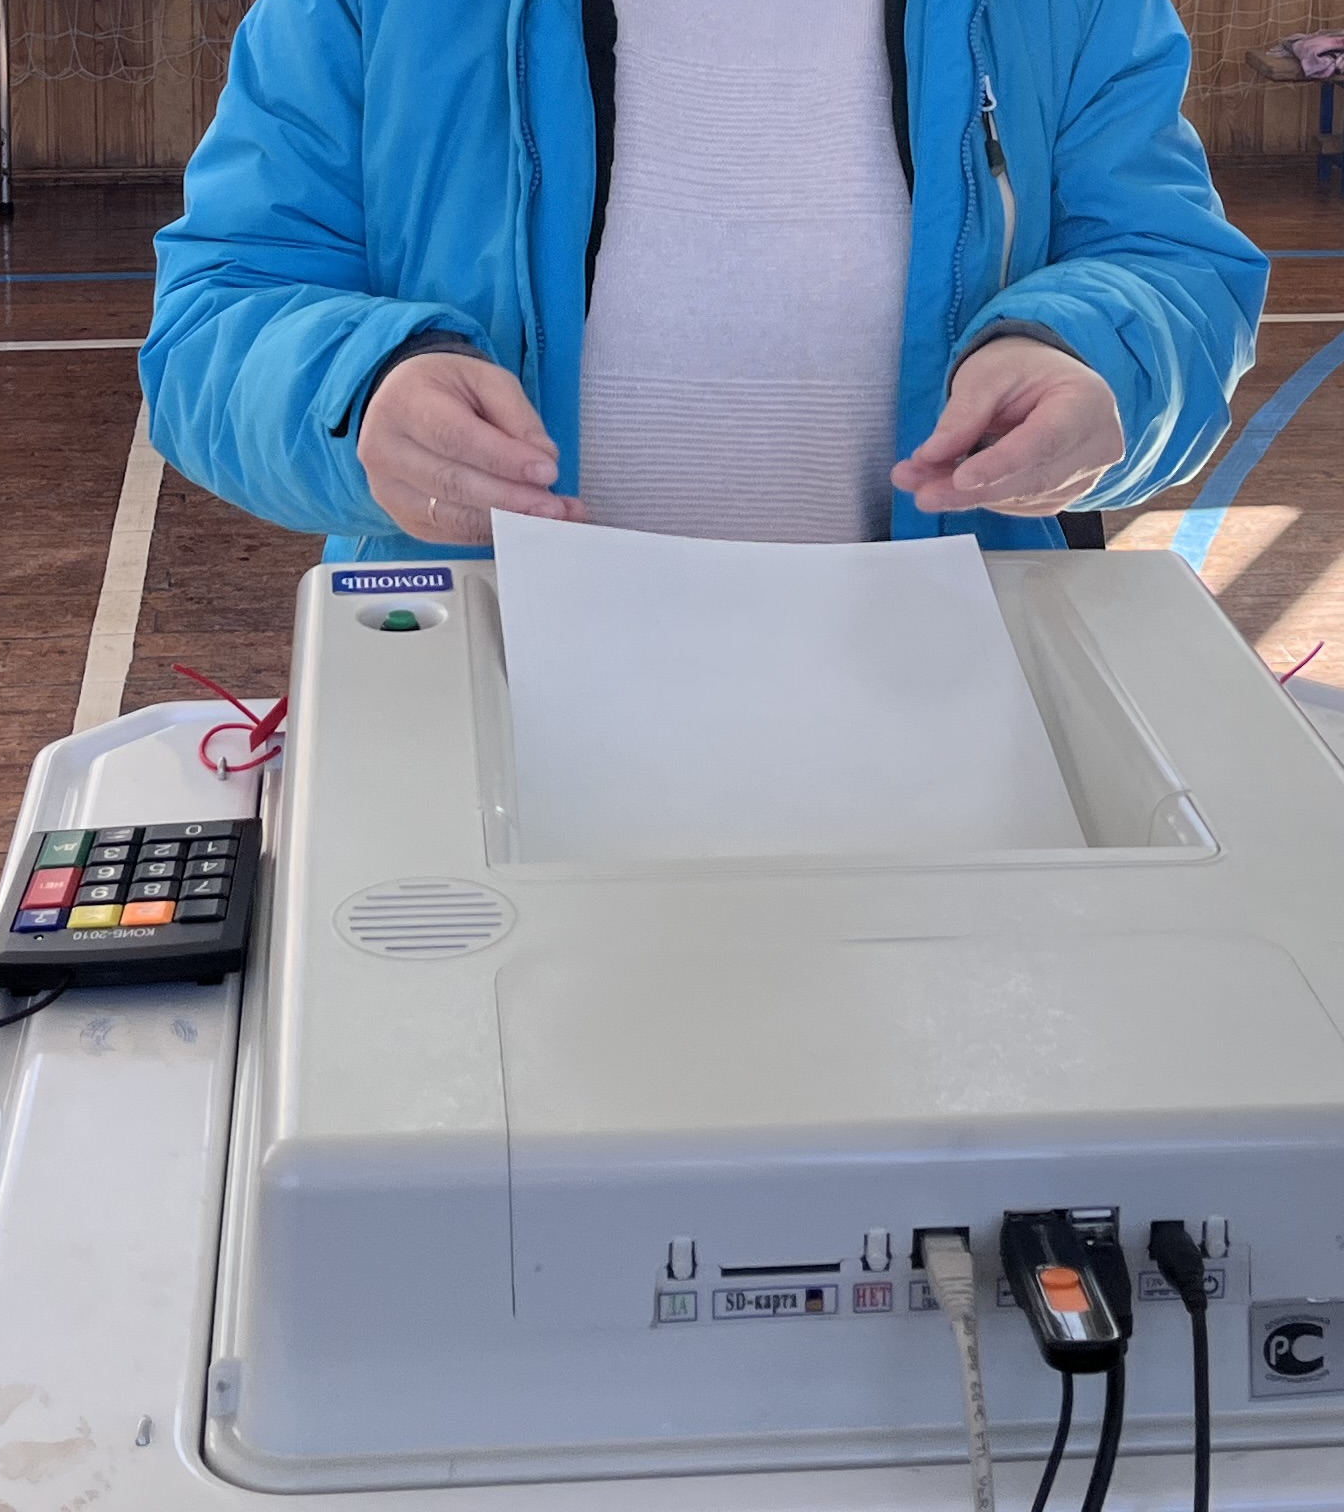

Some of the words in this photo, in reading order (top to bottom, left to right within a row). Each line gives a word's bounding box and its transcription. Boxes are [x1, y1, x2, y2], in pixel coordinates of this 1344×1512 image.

[340, 574, 445, 589] ПОМОЩЬ
[103, 846, 121, 859] 3
[153, 843, 173, 857] 2
[205, 841, 219, 853] 1
[97, 865, 115, 879] 6
[149, 862, 167, 876] 5
[201, 861, 219, 873] 4
[90, 885, 109, 899] 9
[143, 882, 162, 896] 8
[193, 880, 210, 893] 7
[72, 926, 156, 942] КОИБ-2010
[667, 1293, 689, 1316] ДА
[725, 1292, 799, 1315] SD-карта
[856, 1286, 891, 1309] НЕТ
